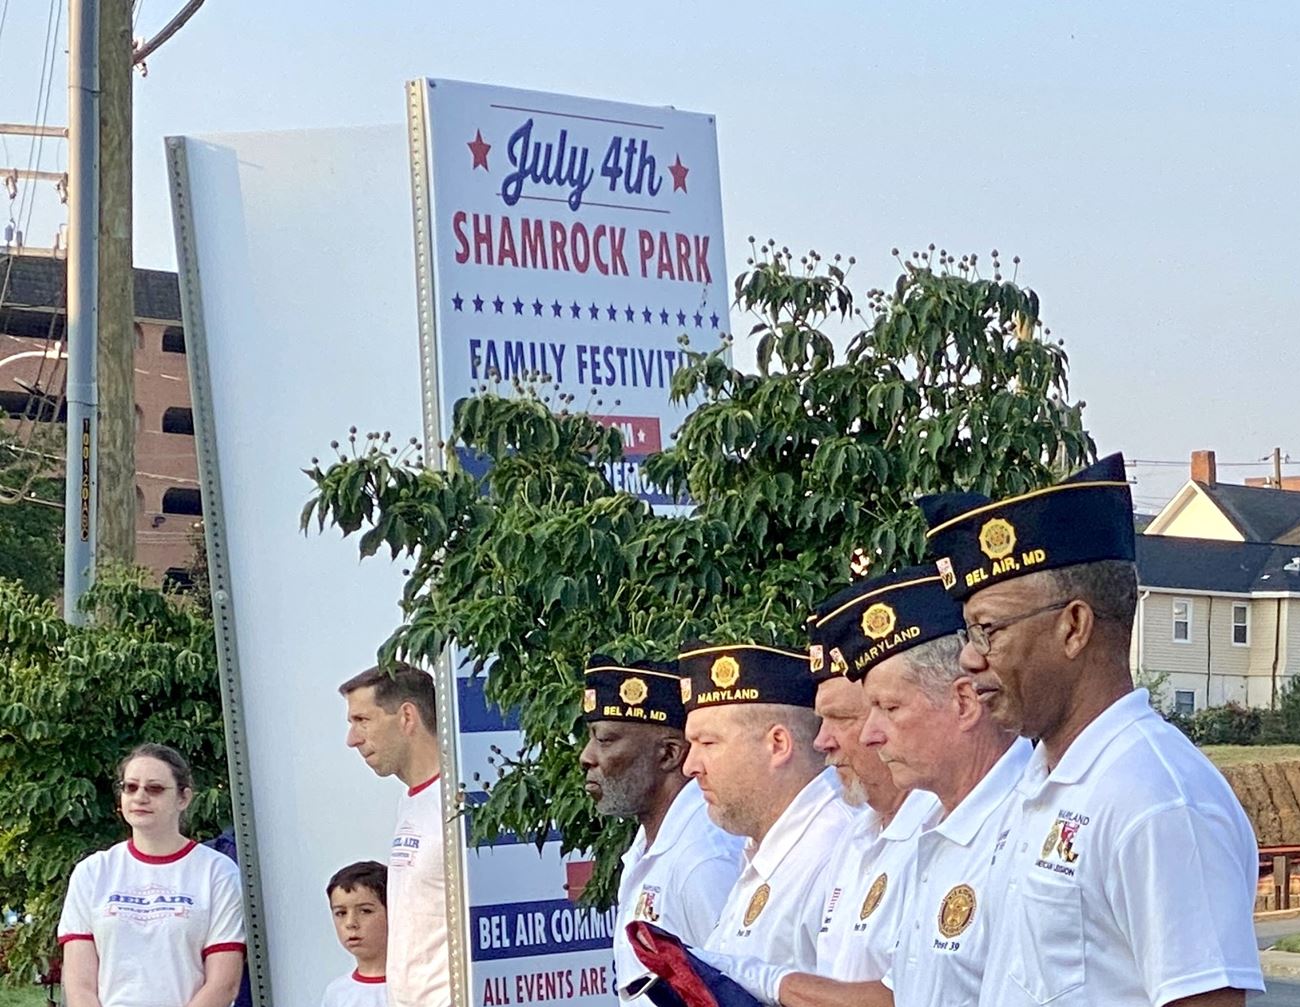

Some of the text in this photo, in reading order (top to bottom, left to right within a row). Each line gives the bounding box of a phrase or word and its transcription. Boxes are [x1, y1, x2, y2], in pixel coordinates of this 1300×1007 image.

[502, 118, 663, 212] July 4th
[452, 211, 713, 284] SHAMROCK PARK
[469, 338, 692, 389] FAMILY FESTIVIT
[966, 549, 1046, 588] BEL AIR, MD
[854, 625, 921, 671] MARYLAND
[603, 705, 667, 721] BEL AIR, MD
[697, 687, 759, 704] MARYLAND
[479, 914, 510, 950] BEL
[515, 912, 547, 947] AIR
[933, 938, 960, 952] Post 39
[483, 976, 510, 1007] ALL
[516, 969, 574, 1004] EVENTS
[579, 966, 607, 997] ARE
